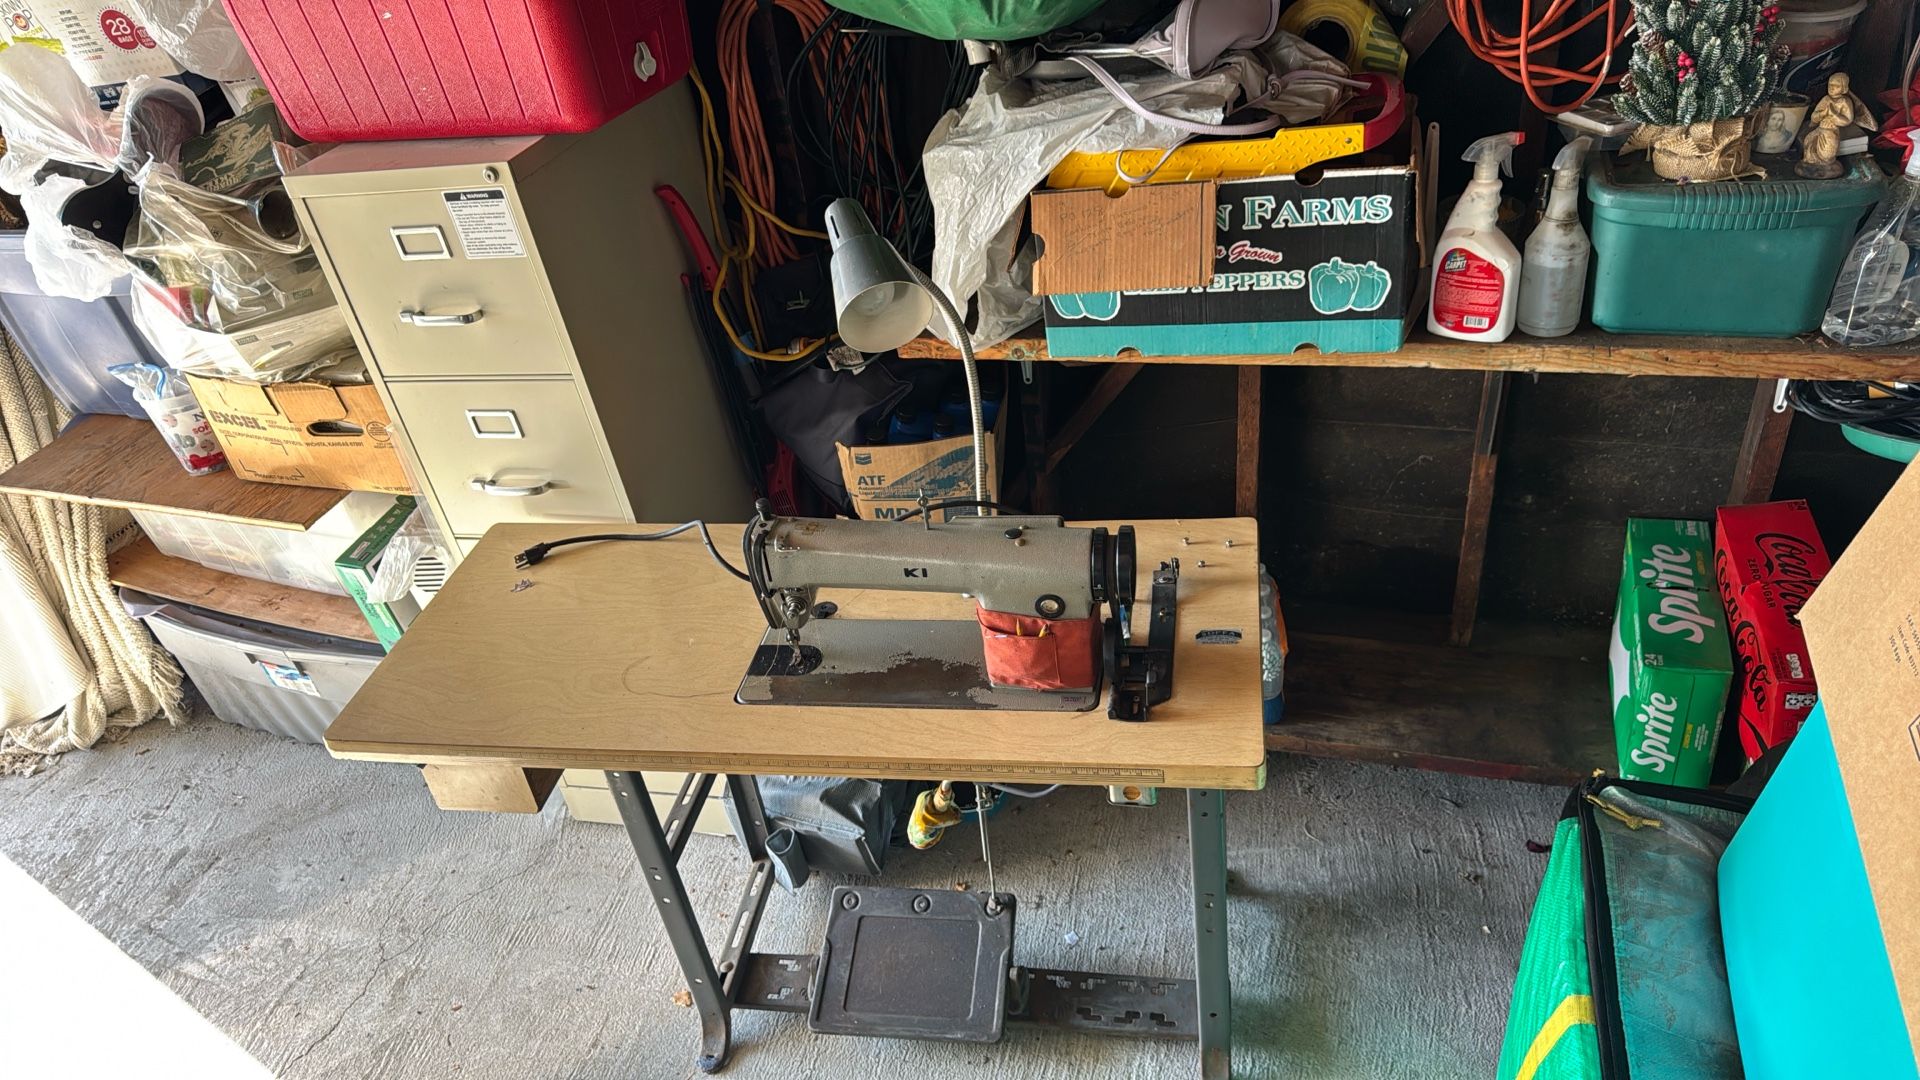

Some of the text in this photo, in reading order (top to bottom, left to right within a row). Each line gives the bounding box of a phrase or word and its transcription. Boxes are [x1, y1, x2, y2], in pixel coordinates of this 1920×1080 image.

[105, 18, 131, 36] 28
[1242, 195, 1392, 230] FARMS
[1229, 241, 1283, 264] Grown
[208, 410, 267, 431] EXCEL
[857, 475, 886, 486] ATF
[1640, 544, 1716, 644] Sprite
[1761, 581, 1777, 609] UGAR
[1645, 653, 1657, 665] 24
[1630, 692, 1677, 773] Sprite
